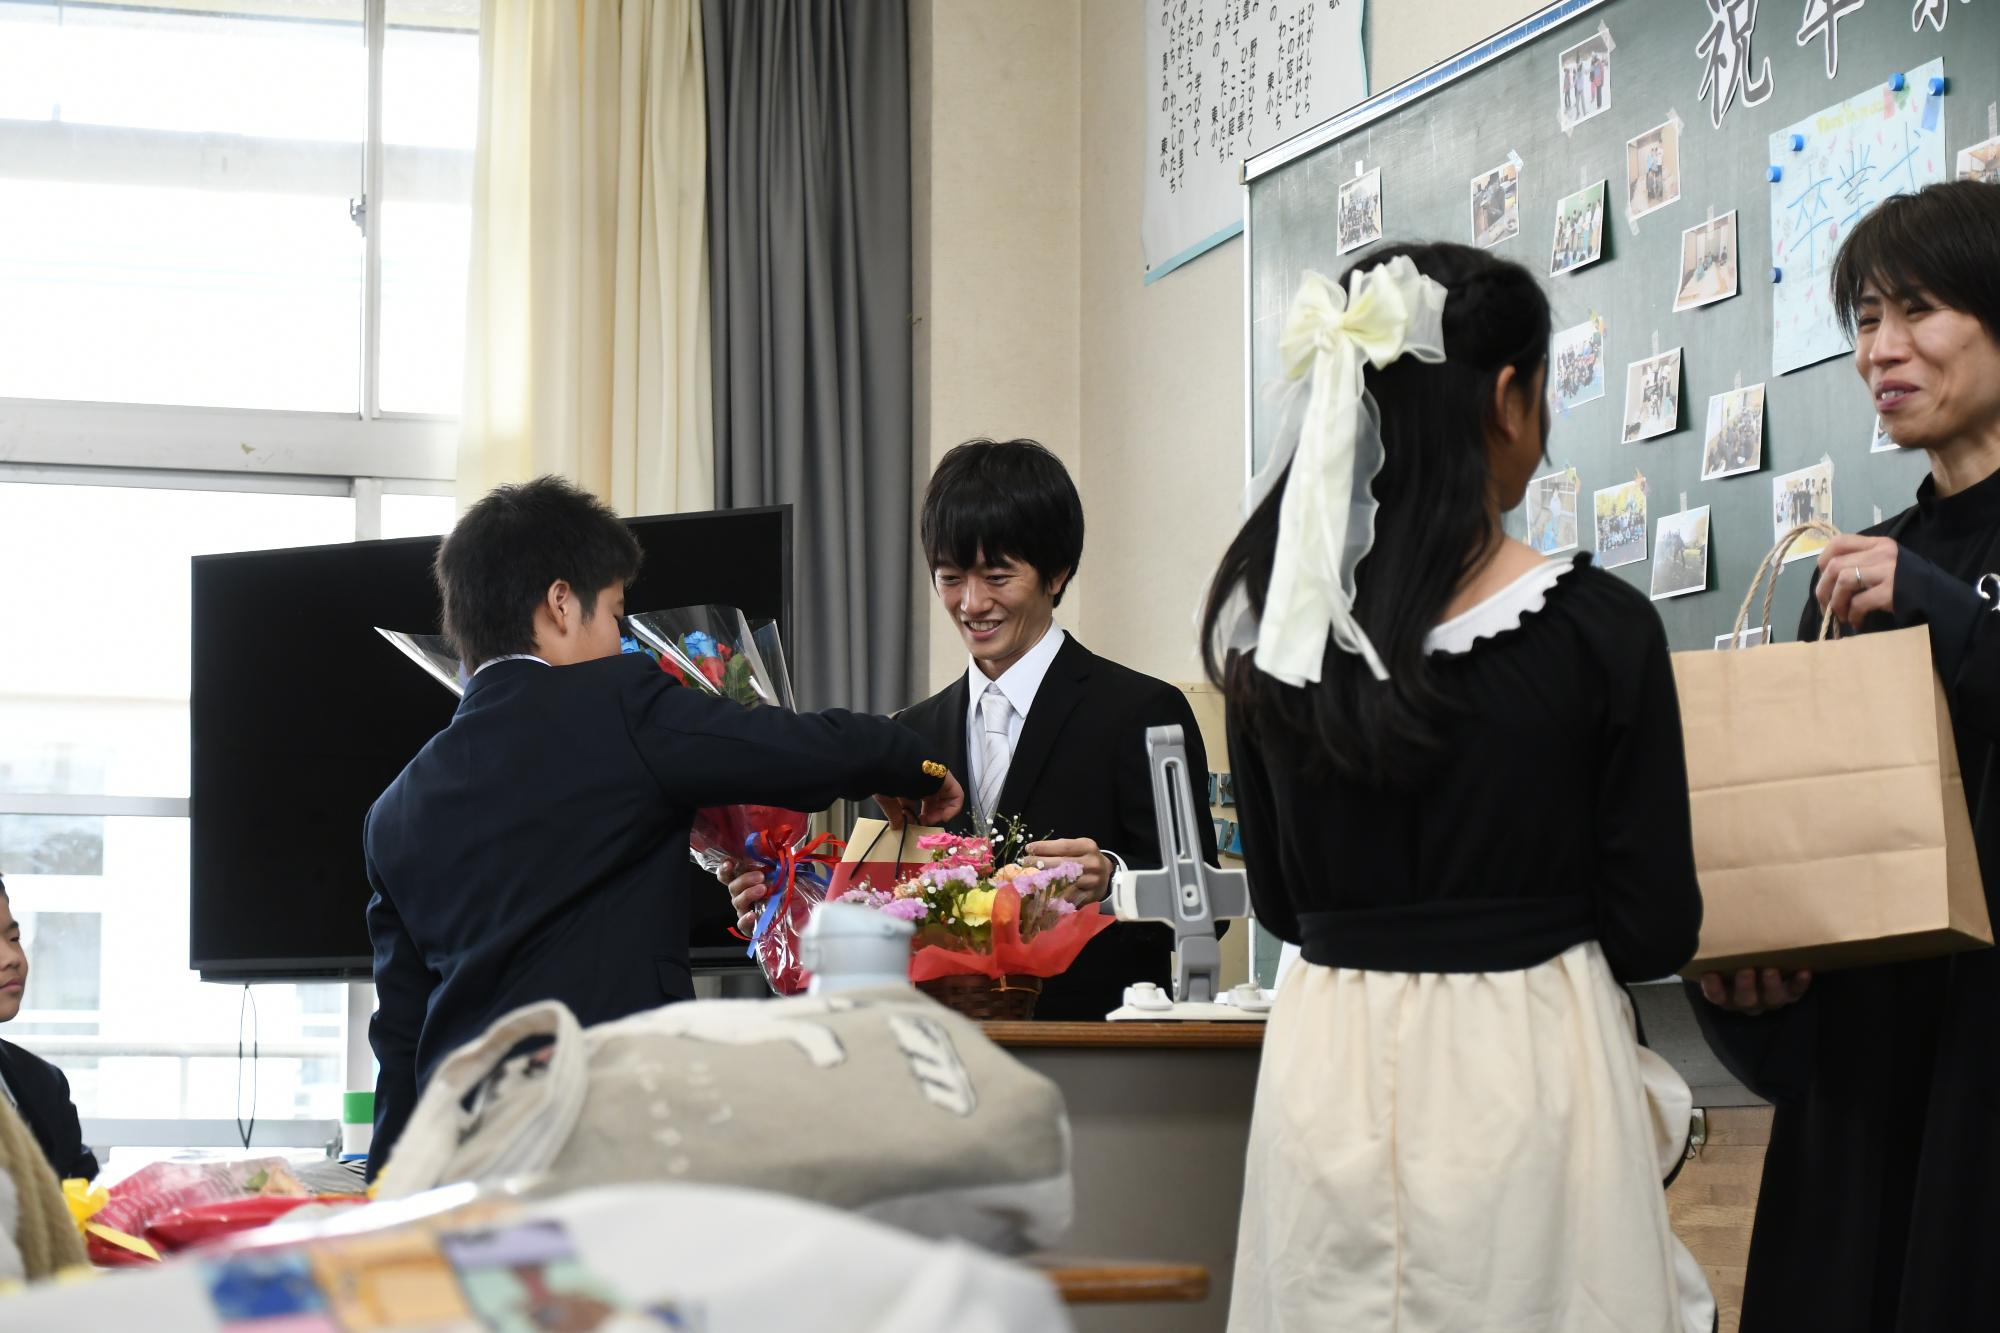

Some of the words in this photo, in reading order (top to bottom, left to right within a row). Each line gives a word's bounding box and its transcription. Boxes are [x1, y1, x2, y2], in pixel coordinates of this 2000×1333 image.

[1219, 58, 1229, 164] わたしたち
[1276, 21, 1287, 131] わたしたち
